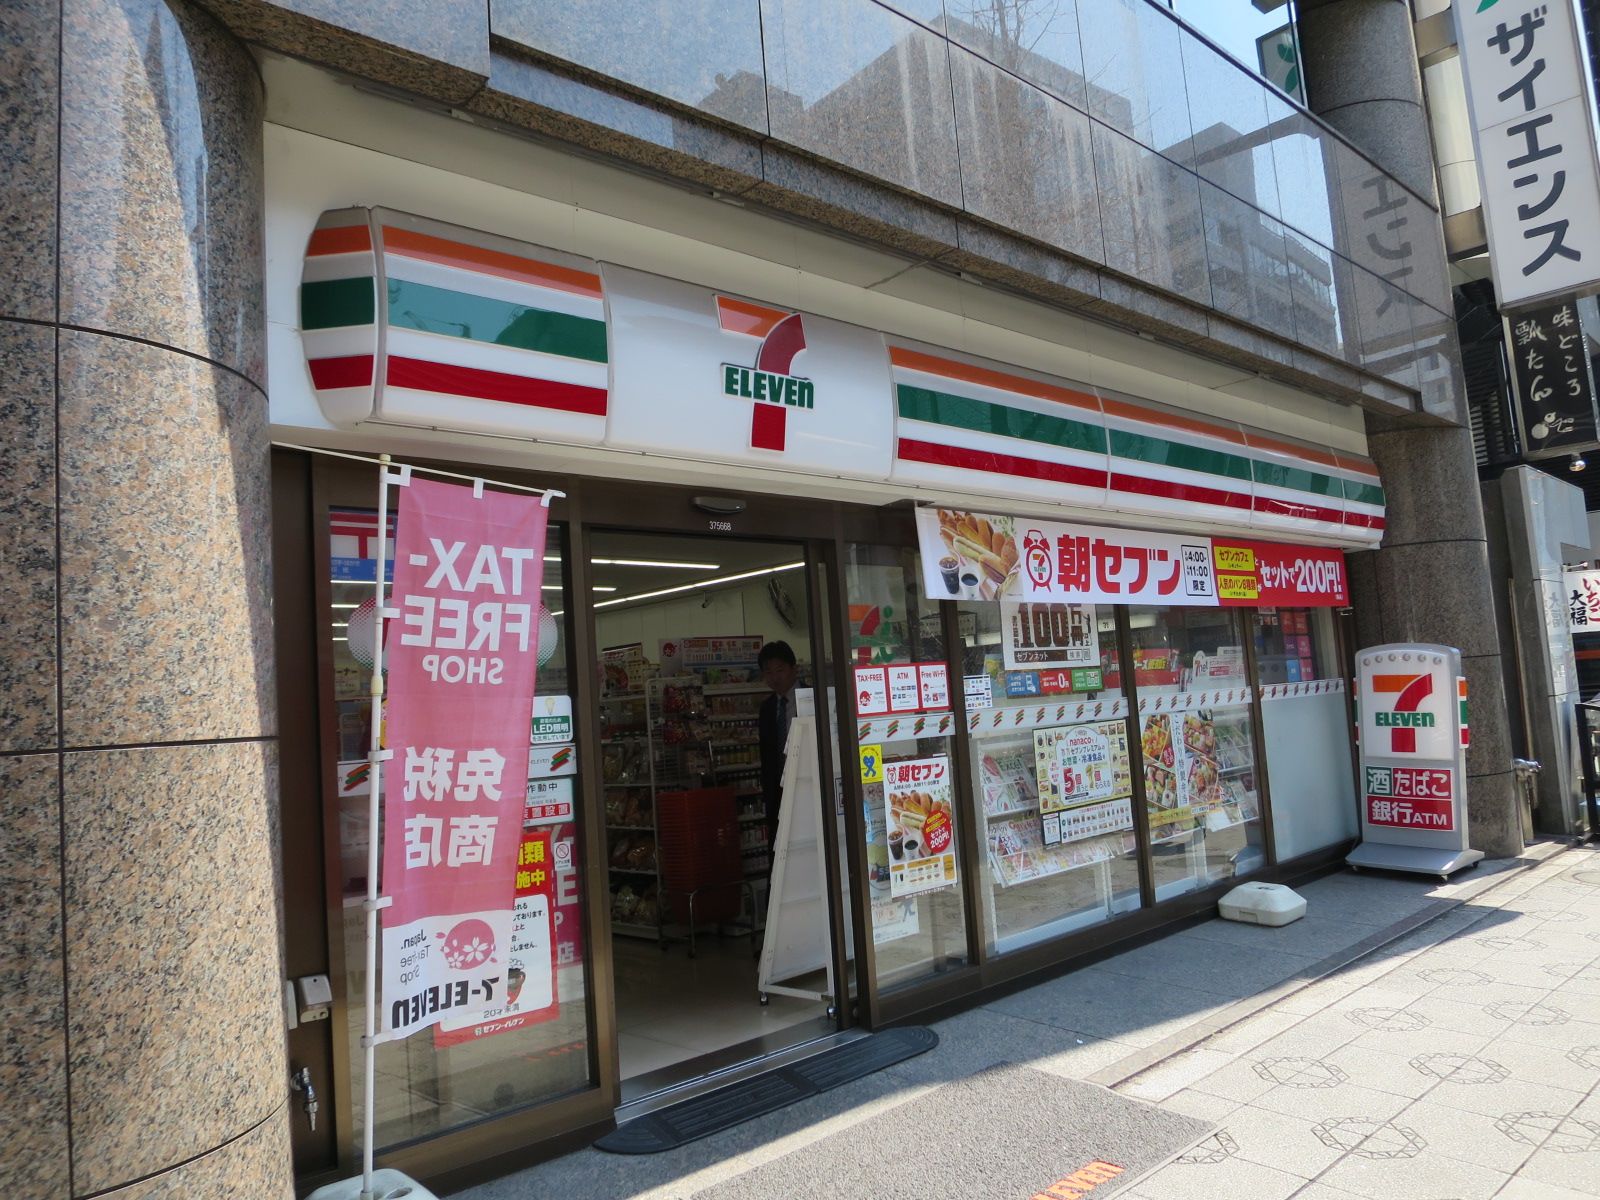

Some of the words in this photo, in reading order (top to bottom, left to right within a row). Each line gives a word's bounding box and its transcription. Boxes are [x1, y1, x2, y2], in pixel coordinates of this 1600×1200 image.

[1552, 305, 1581, 396] 味どころ
[1057, 534, 1181, 595] 朝セブン
[1569, 589, 1587, 626] 大福
[1016, 650, 1049, 662] セブンネット
[857, 673, 883, 683] TAX-FREE
[896, 672, 910, 680] ATM
[898, 764, 945, 783] 朝セブン
[1368, 769, 1391, 793] 酒
[1394, 770, 1449, 797] たばこ
